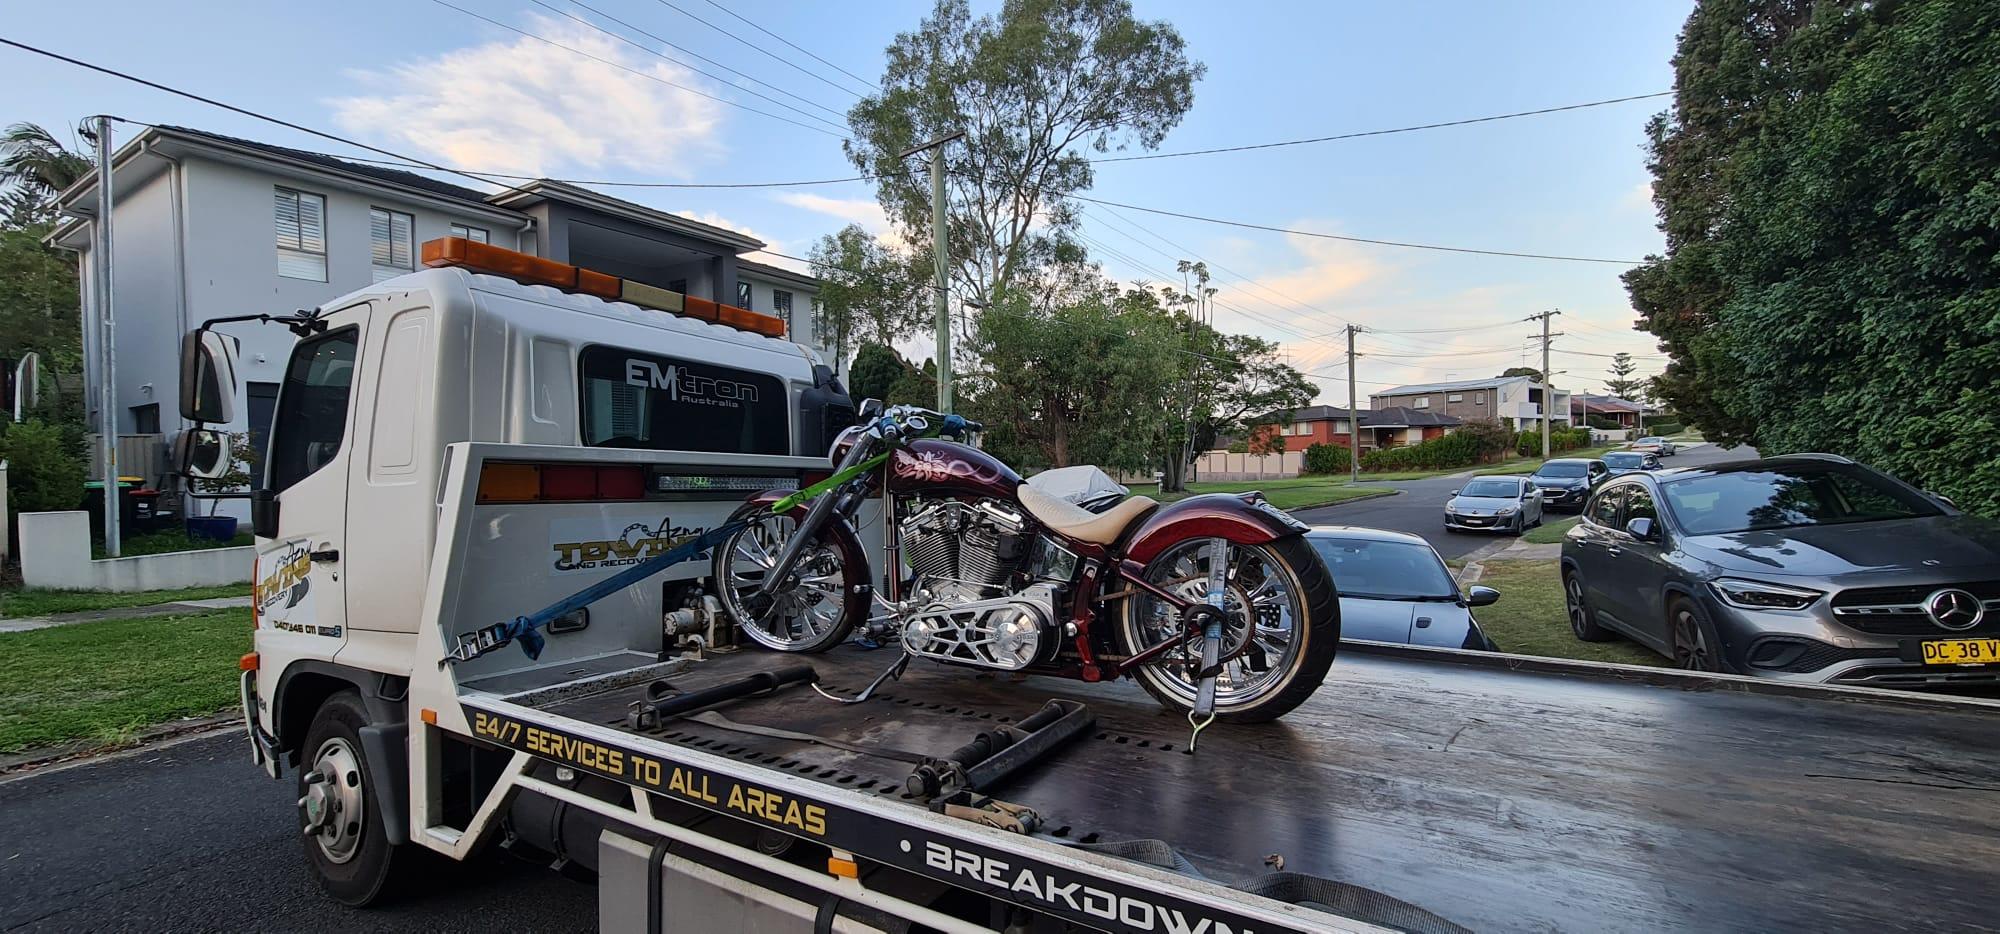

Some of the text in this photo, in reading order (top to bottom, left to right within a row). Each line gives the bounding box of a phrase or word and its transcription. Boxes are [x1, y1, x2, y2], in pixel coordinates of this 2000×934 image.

[626, 358, 759, 402] EMtron
[681, 395, 739, 408] Australia
[554, 535, 698, 563] TOWIN
[567, 556, 652, 570] AND RECOV
[1924, 641, 2000, 659] DC 38 V
[475, 712, 826, 836] 24/7 SERVICES TO ALL AREAS
